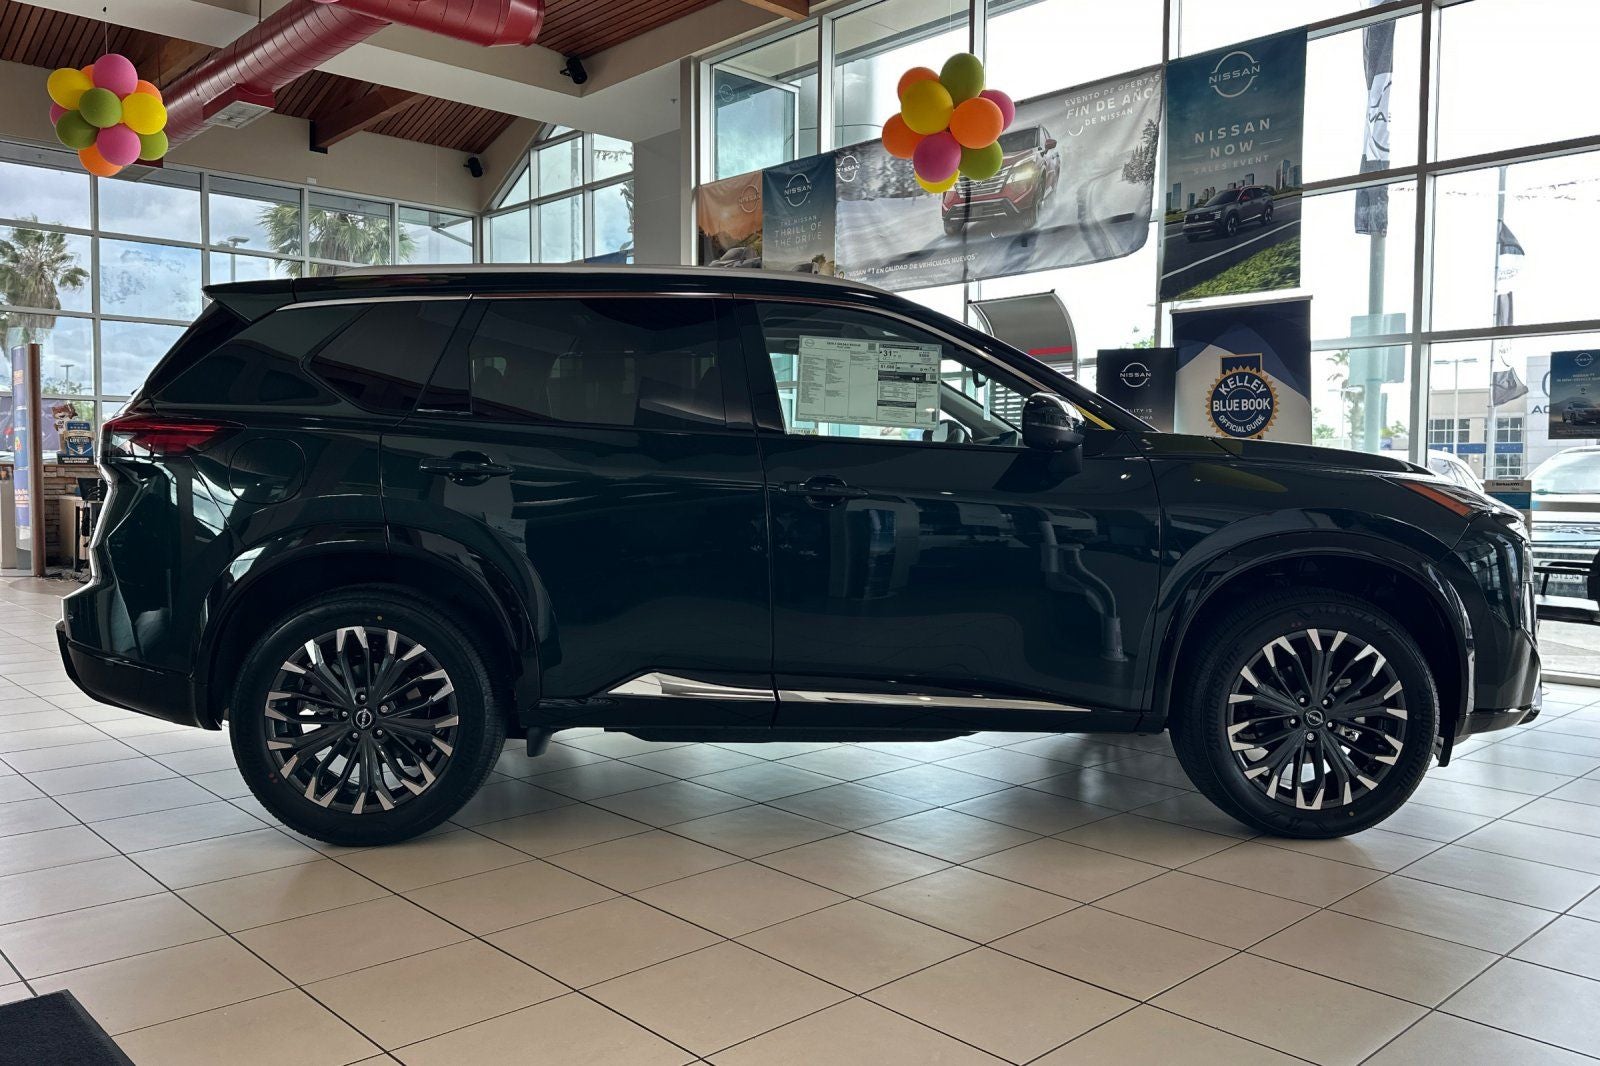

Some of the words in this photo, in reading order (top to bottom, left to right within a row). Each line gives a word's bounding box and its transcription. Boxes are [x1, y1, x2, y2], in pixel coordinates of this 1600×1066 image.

[1208, 64, 1261, 84] NISSAN
[1064, 91, 1100, 107] EVENTO
[1103, 87, 1115, 96] DE
[1117, 74, 1160, 91] OFERTAS
[1066, 104, 1090, 120] FIN
[1096, 97, 1116, 112] DE
[1085, 117, 1097, 126] DE
[1100, 106, 1134, 122] NISSAN
[1194, 117, 1270, 144] NISSAN
[1210, 139, 1254, 159] NOW
[835, 162, 860, 172] NISSAN
[1193, 162, 1227, 176] SALES
[1233, 154, 1270, 168] EVENT
[784, 184, 812, 195] NISSAN
[793, 214, 817, 224] NISSAN
[774, 225, 806, 238] THRILL
[810, 221, 822, 232] OF
[774, 237, 791, 248] THE
[795, 231, 822, 245] DRIVE
[884, 264, 908, 273] CALIDAD
[1218, 375, 1267, 396] KELLEY
[1212, 400, 1240, 412] BLUE
[1241, 397, 1271, 411] BOOK
[1218, 414, 1247, 433] OFFICIAL
[1246, 414, 1266, 432] GUIDE
